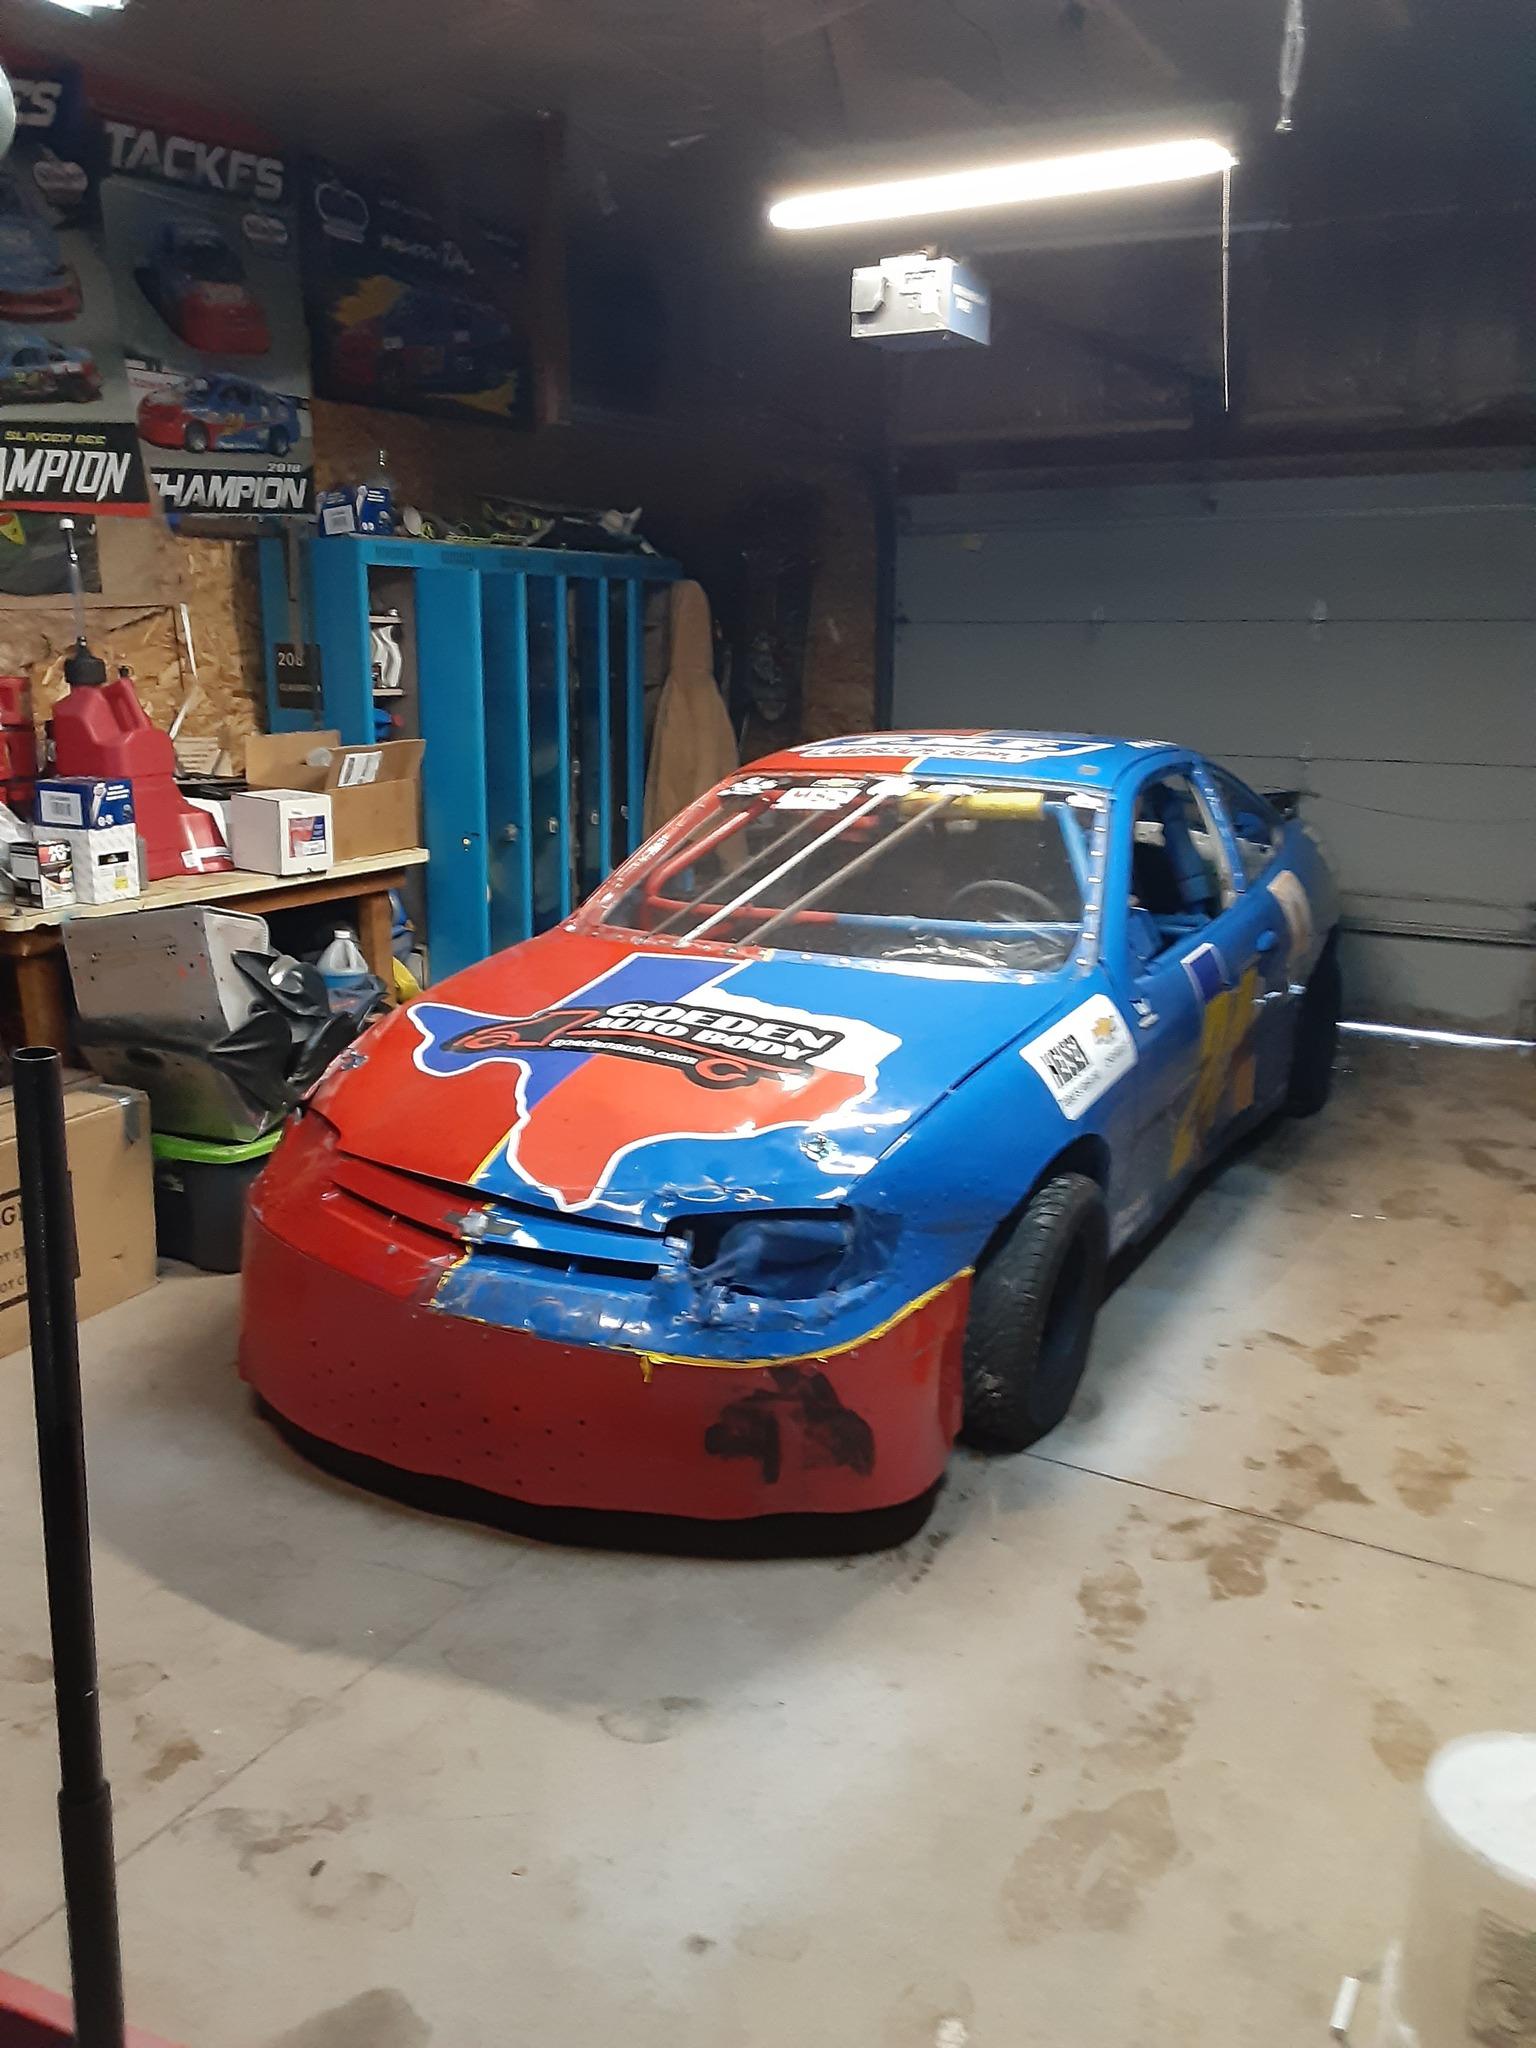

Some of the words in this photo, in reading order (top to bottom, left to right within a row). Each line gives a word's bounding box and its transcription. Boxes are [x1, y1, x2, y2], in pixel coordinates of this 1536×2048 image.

[583, 1016, 691, 1038] AUTO
[691, 1028, 818, 1062] BODY
[606, 1003, 836, 1050] GOEDEN
